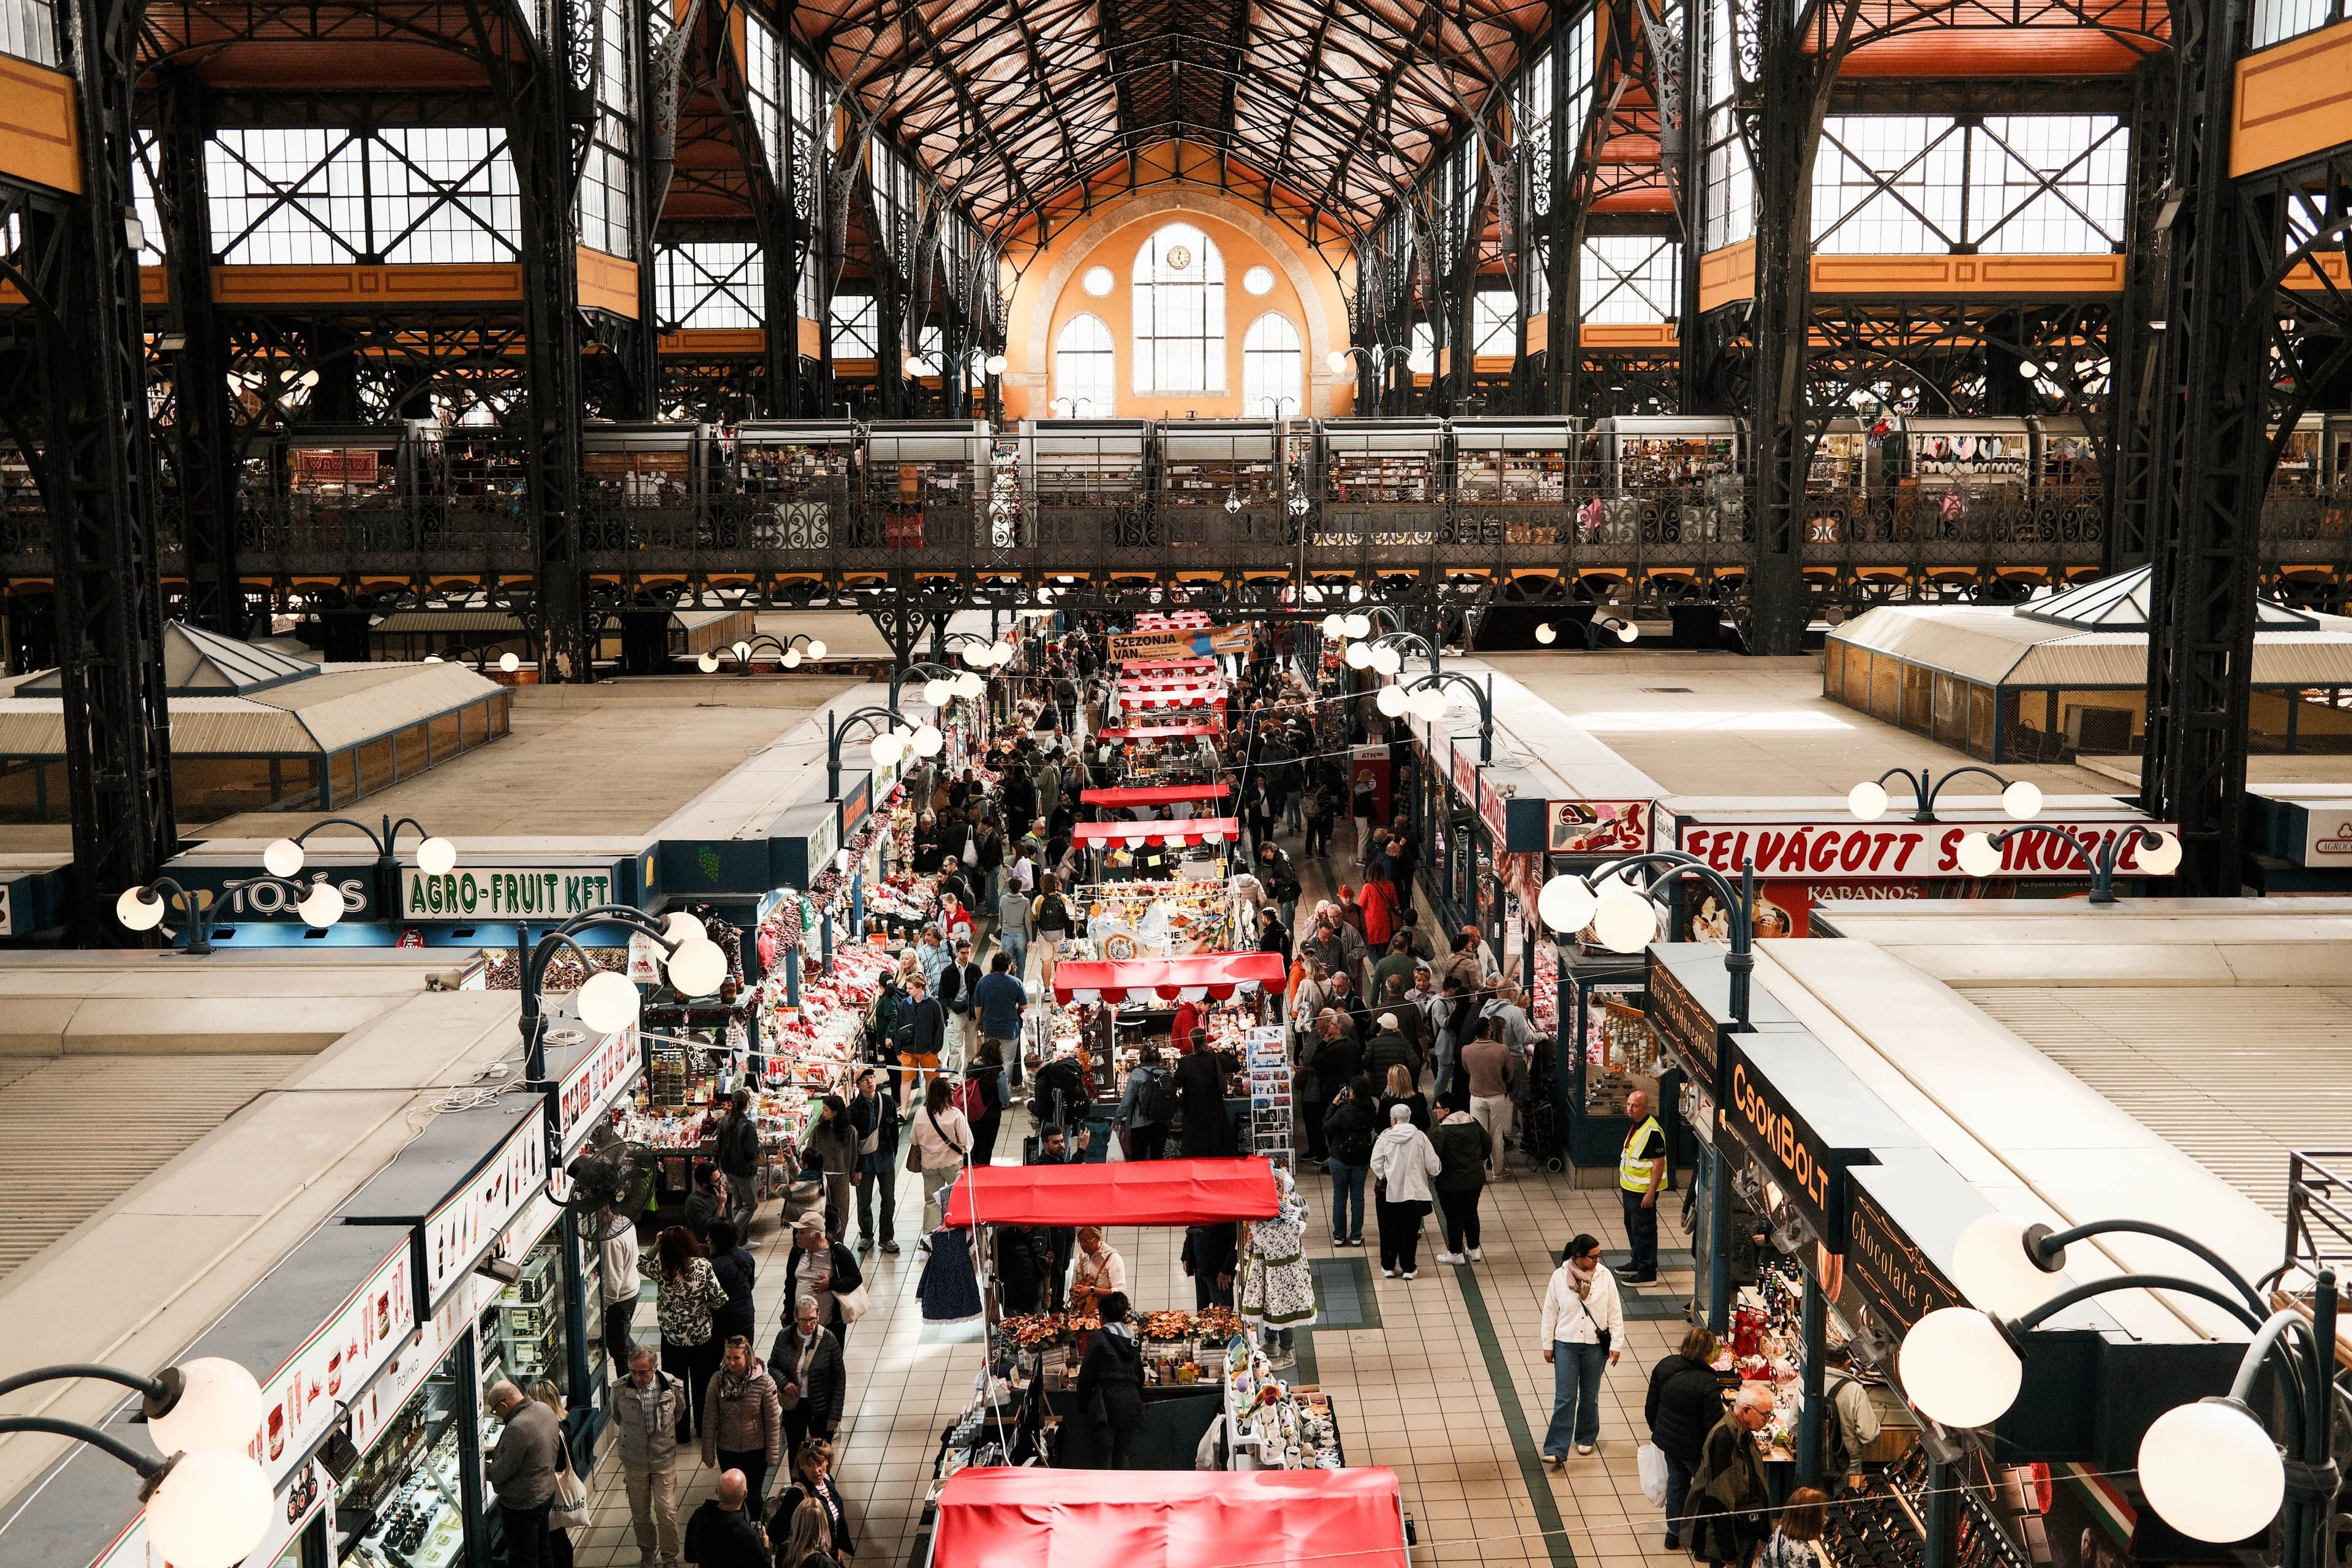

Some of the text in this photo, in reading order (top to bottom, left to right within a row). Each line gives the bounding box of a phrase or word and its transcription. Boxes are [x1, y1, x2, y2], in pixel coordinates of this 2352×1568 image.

[1113, 634, 1177, 648] SZEZONJA
[1113, 649, 1143, 660] VAN.
[1687, 827, 1923, 873] FELVÁGOTT
[224, 872, 368, 913] TOJS
[409, 873, 559, 914] AGRO-FRUIT
[1807, 886, 1919, 901] KABANOS
[1649, 974, 1717, 1069] Kávé Tea Hungaricum
[1852, 1210, 1917, 1308] Chocolate
[396, 1358, 420, 1392] Pálinka
